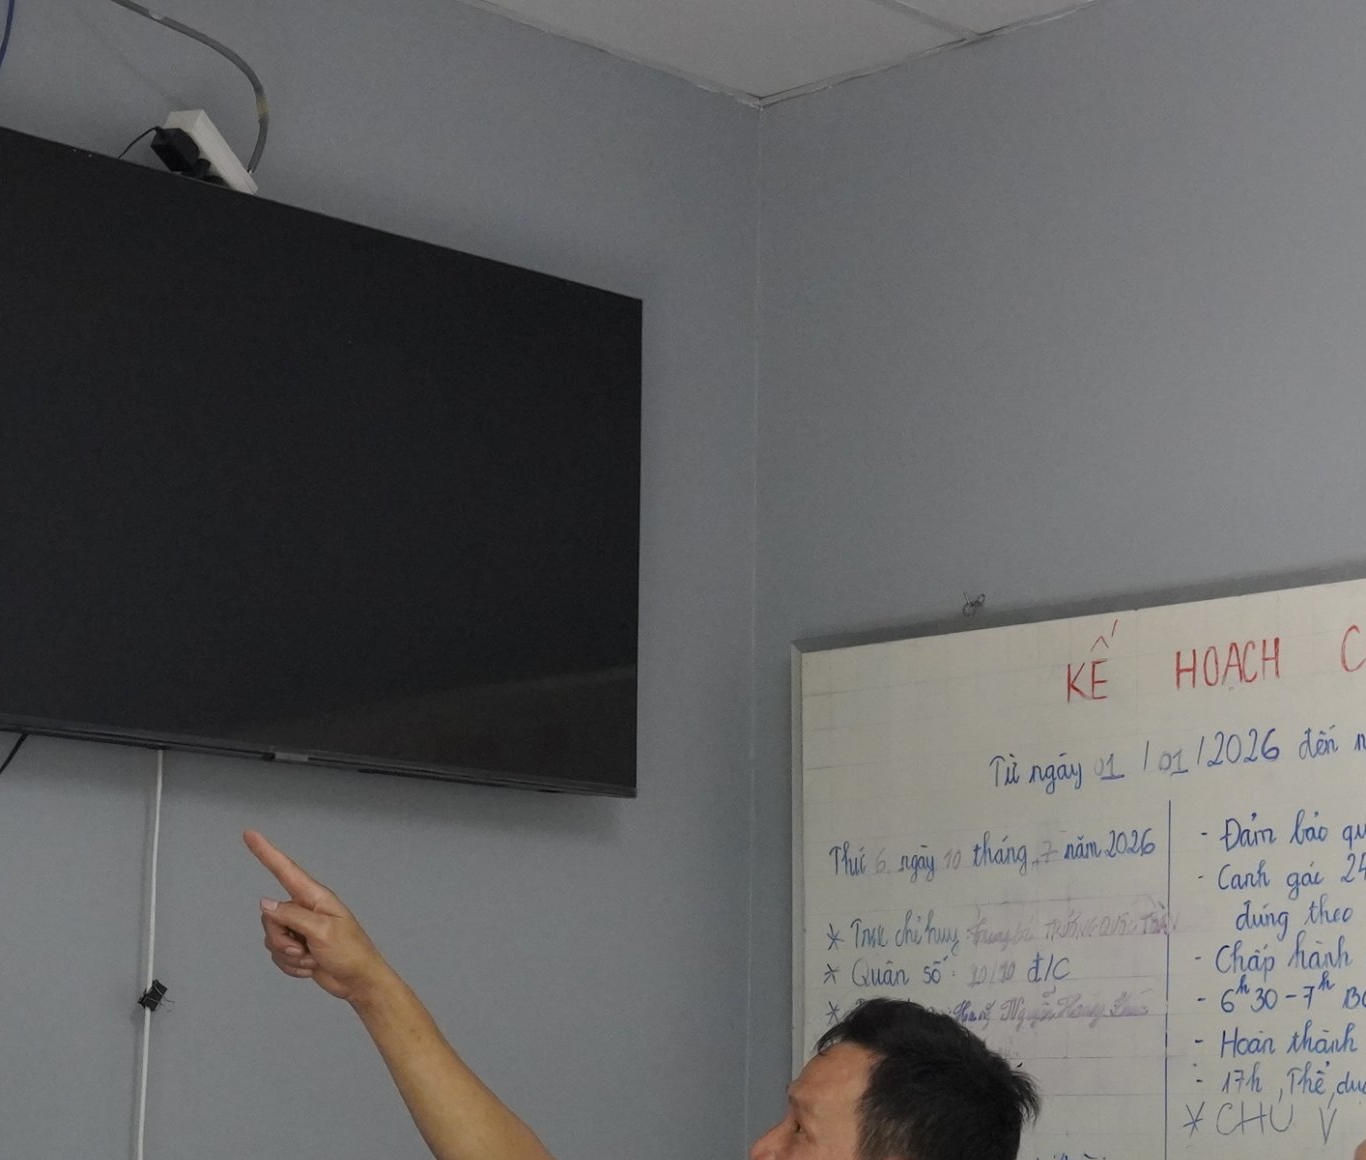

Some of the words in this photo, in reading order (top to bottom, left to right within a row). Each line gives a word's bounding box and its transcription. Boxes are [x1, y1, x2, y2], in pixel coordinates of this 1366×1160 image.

[1066, 619, 1118, 703] KẾ
[1029, 750, 1083, 794] ngày
[1298, 724, 1339, 761] đến
[1219, 812, 1277, 852] Đảm
[1289, 809, 1329, 844] bảo
[898, 844, 936, 883] ngày
[972, 831, 1028, 876] tháng
[1063, 831, 1102, 859] năm
[1103, 828, 1156, 858] 2026
[1217, 858, 1272, 893] Canh
[1235, 899, 1290, 941] đúng
[1304, 894, 1354, 926] theo
[852, 958, 910, 987] Quân
[1215, 944, 1276, 985] Chấp
[1287, 928, 1353, 970] hành
[1220, 1020, 1276, 1058] Hoàn
[1287, 1019, 1358, 1056] thành
[1216, 1088, 1294, 1136] CHÚ
